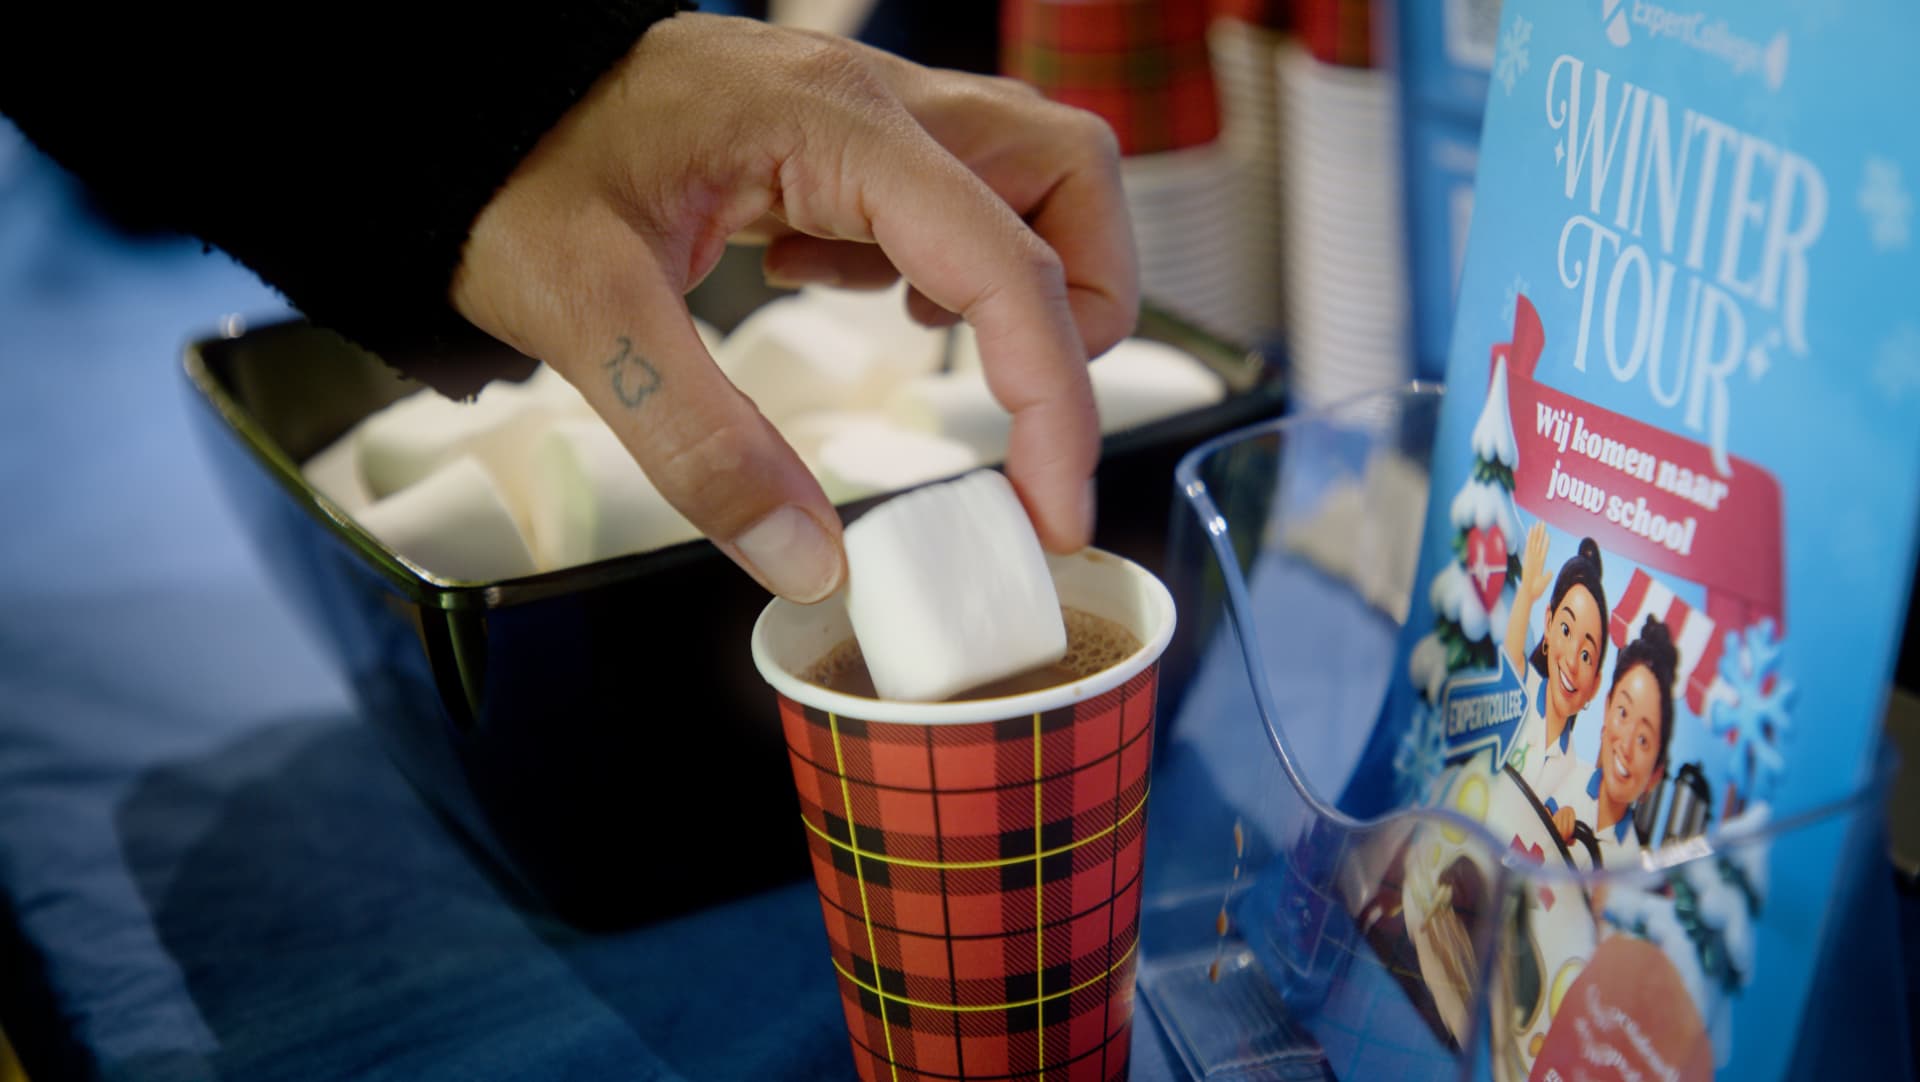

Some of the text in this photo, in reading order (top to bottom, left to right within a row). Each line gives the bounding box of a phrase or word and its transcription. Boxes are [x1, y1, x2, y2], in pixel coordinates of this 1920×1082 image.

[1546, 55, 1828, 358] WINTER
[1557, 215, 1747, 478] TOUR
[1536, 402, 1729, 511] Wij komen naar
[1546, 459, 1697, 556] jouw school
[1448, 690, 1523, 736] EXPERTCOLLEGE
